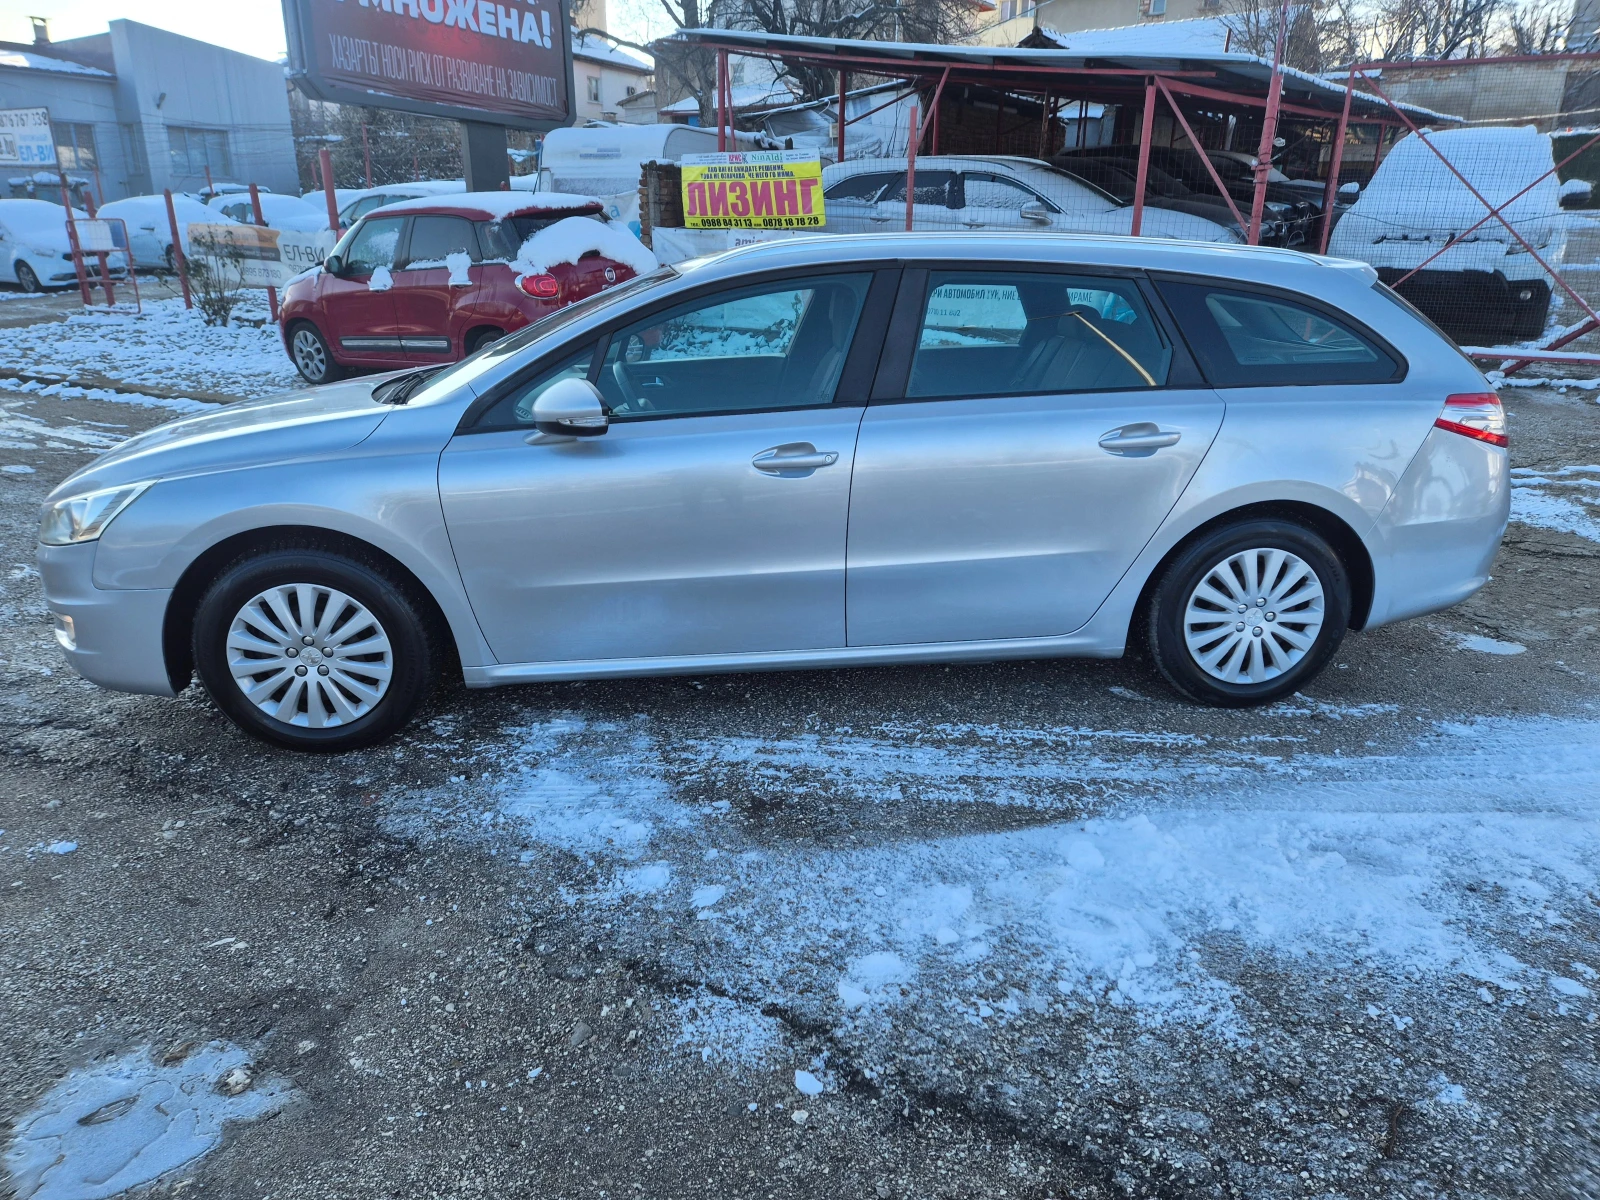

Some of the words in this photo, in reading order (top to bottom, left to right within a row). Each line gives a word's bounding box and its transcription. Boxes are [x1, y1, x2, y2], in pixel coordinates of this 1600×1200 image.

[328, 33, 381, 75] ХАЗАРТЪТ
[380, 44, 409, 81] НОСИ
[407, 49, 434, 85] РИСК
[432, 54, 446, 88] ОТ
[446, 57, 496, 96] РАЗВИВАНЕ
[495, 66, 509, 99] НА
[507, 69, 558, 107] ЗАВИСИМОСТ
[17, 144, 55, 162] ЕЛ-ВИ
[687, 178, 819, 217] ЛИЗИНГ
[701, 218, 722, 227] 0988
[734, 218, 743, 227] 31
[743, 218, 753, 227] 13
[763, 217, 783, 227] 0878
[784, 217, 794, 226] 18
[795, 217, 806, 226] 78
[807, 216, 819, 225] 28
[283, 244, 326, 262] ЕЛ-ВИ
[943, 288, 985, 299] АВТОМОБИЛ
